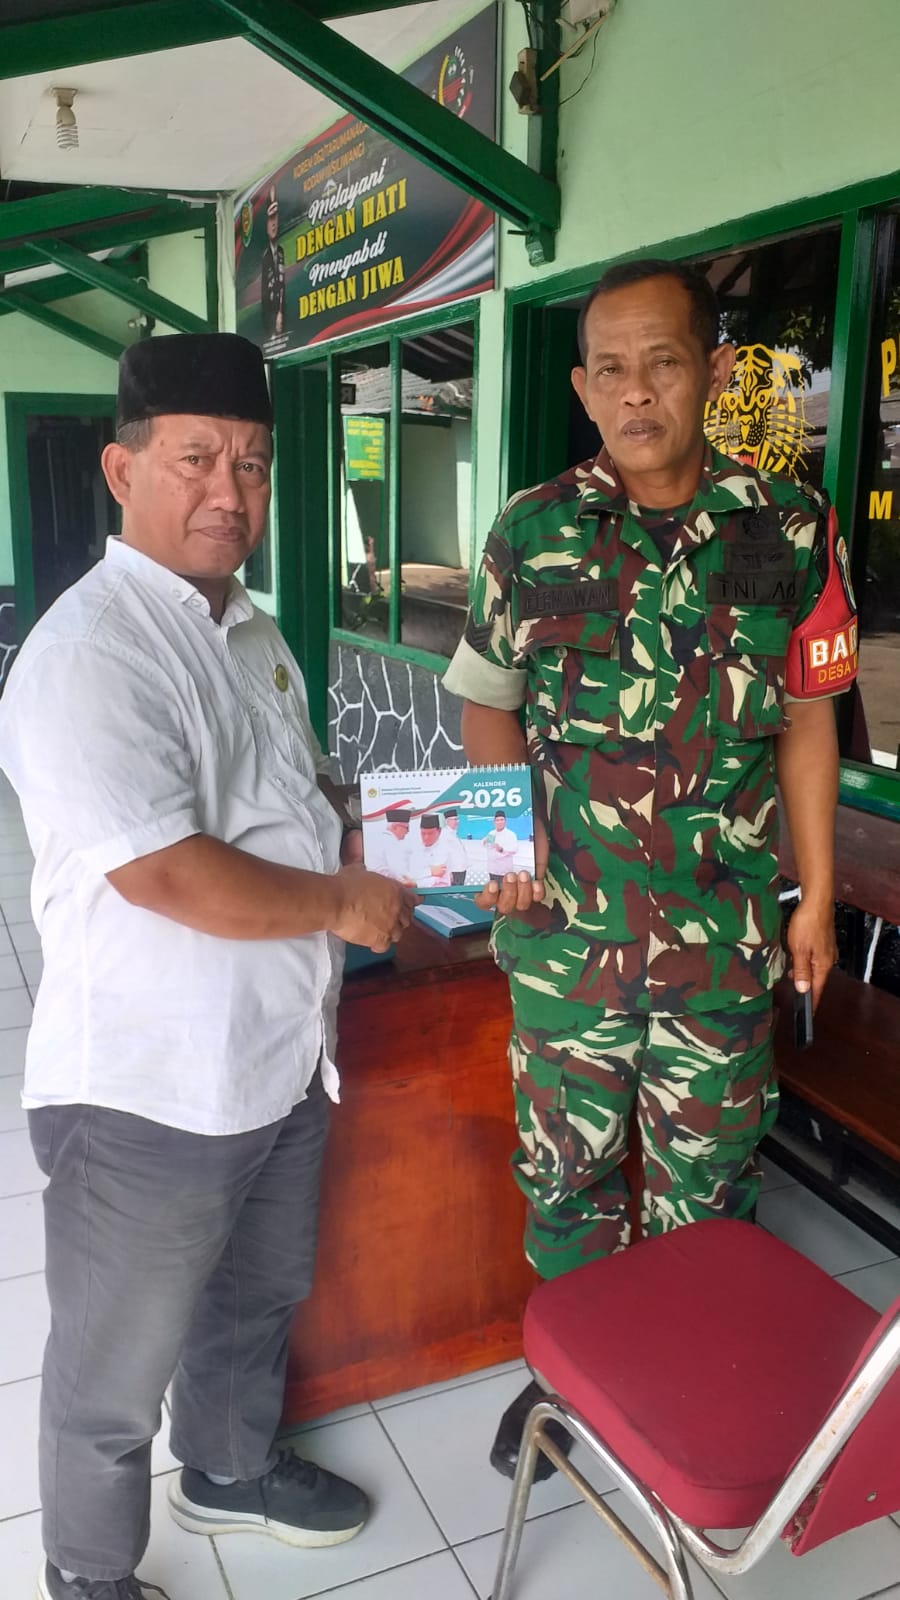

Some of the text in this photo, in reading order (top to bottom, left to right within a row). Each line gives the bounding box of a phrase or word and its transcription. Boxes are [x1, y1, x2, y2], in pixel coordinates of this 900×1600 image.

[296, 178, 407, 261] DENGAN HATI
[308, 157, 387, 226] Melayani
[308, 231, 388, 287] Mengabdi
[299, 255, 405, 320] DENGAN JIWA
[881, 333, 900, 398] P
[717, 579, 757, 600] TNI
[818, 660, 852, 684] DESA
[459, 787, 523, 809] 2026
[473, 780, 507, 788] KALENDER
